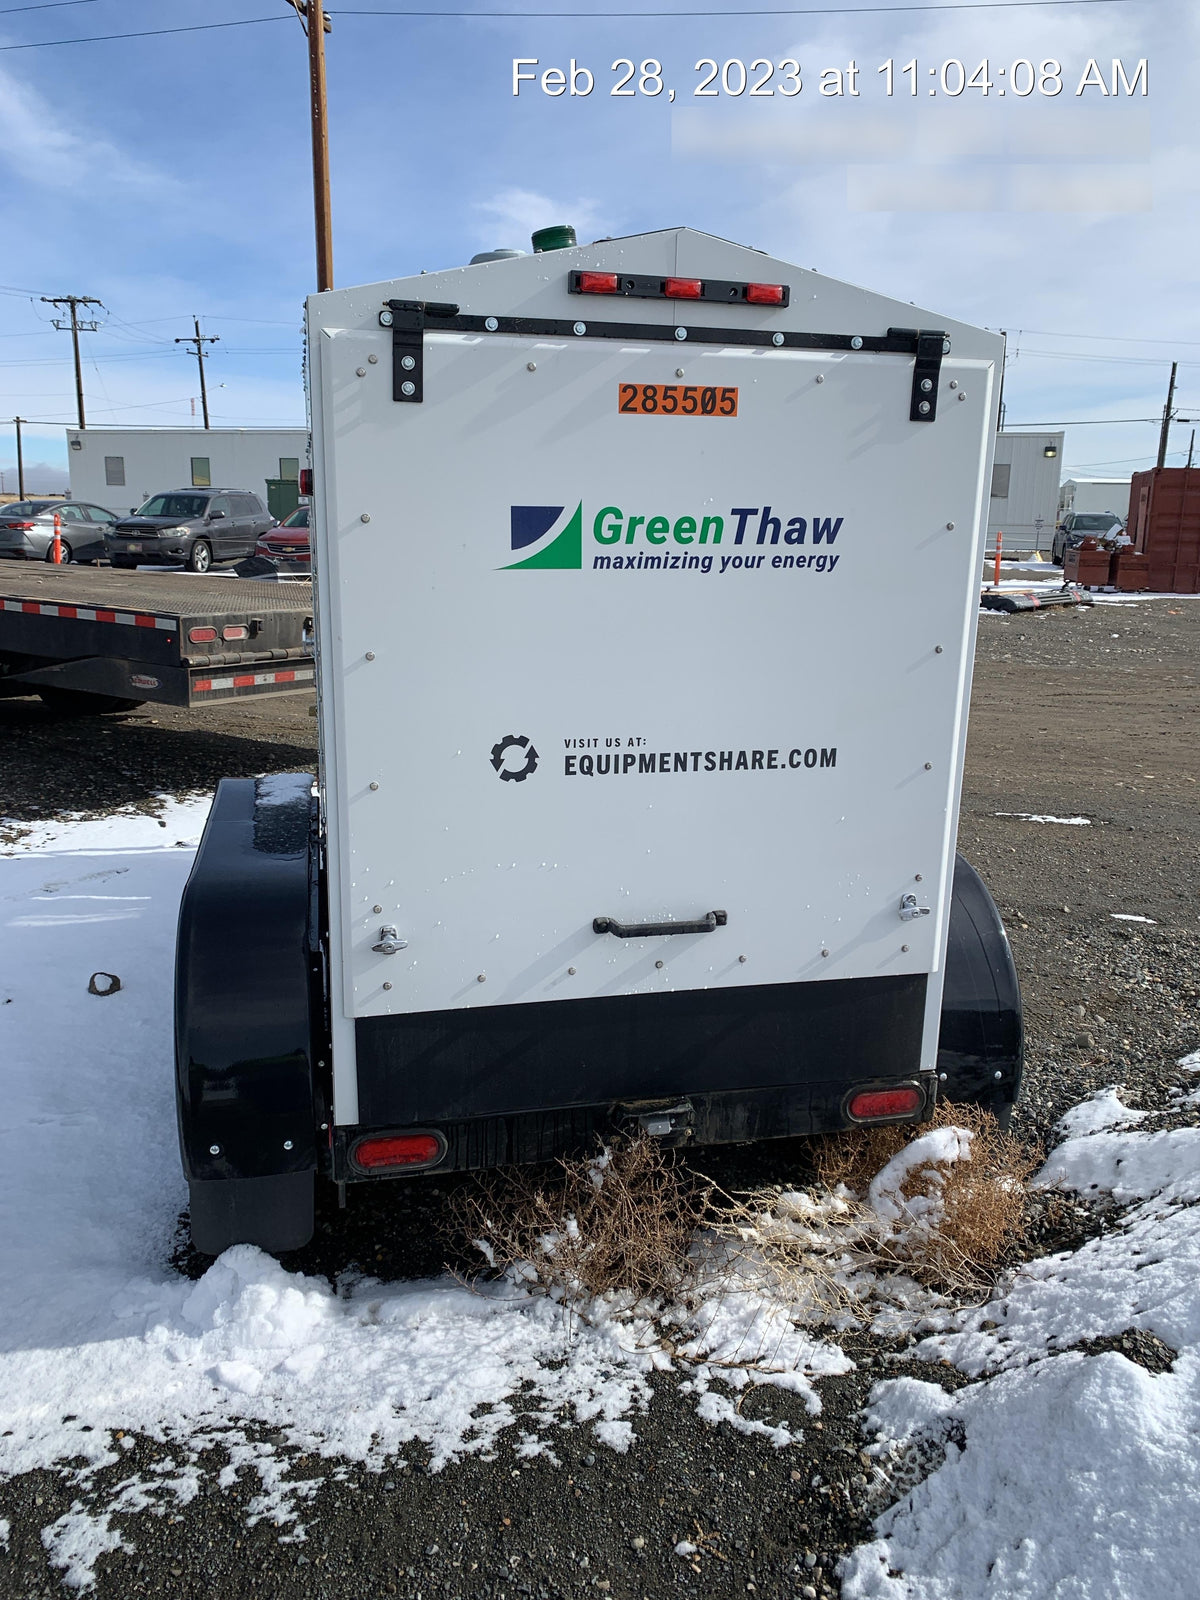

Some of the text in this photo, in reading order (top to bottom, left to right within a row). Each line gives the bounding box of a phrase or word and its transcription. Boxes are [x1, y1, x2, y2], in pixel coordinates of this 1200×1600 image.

[620, 384, 737, 415] 285505
[593, 505, 844, 546] GreenThaw
[592, 551, 840, 574] maximizing your energy
[564, 737, 647, 749] VISIT US AT:
[564, 747, 838, 777] EQUIPMENTSHARE.COM
